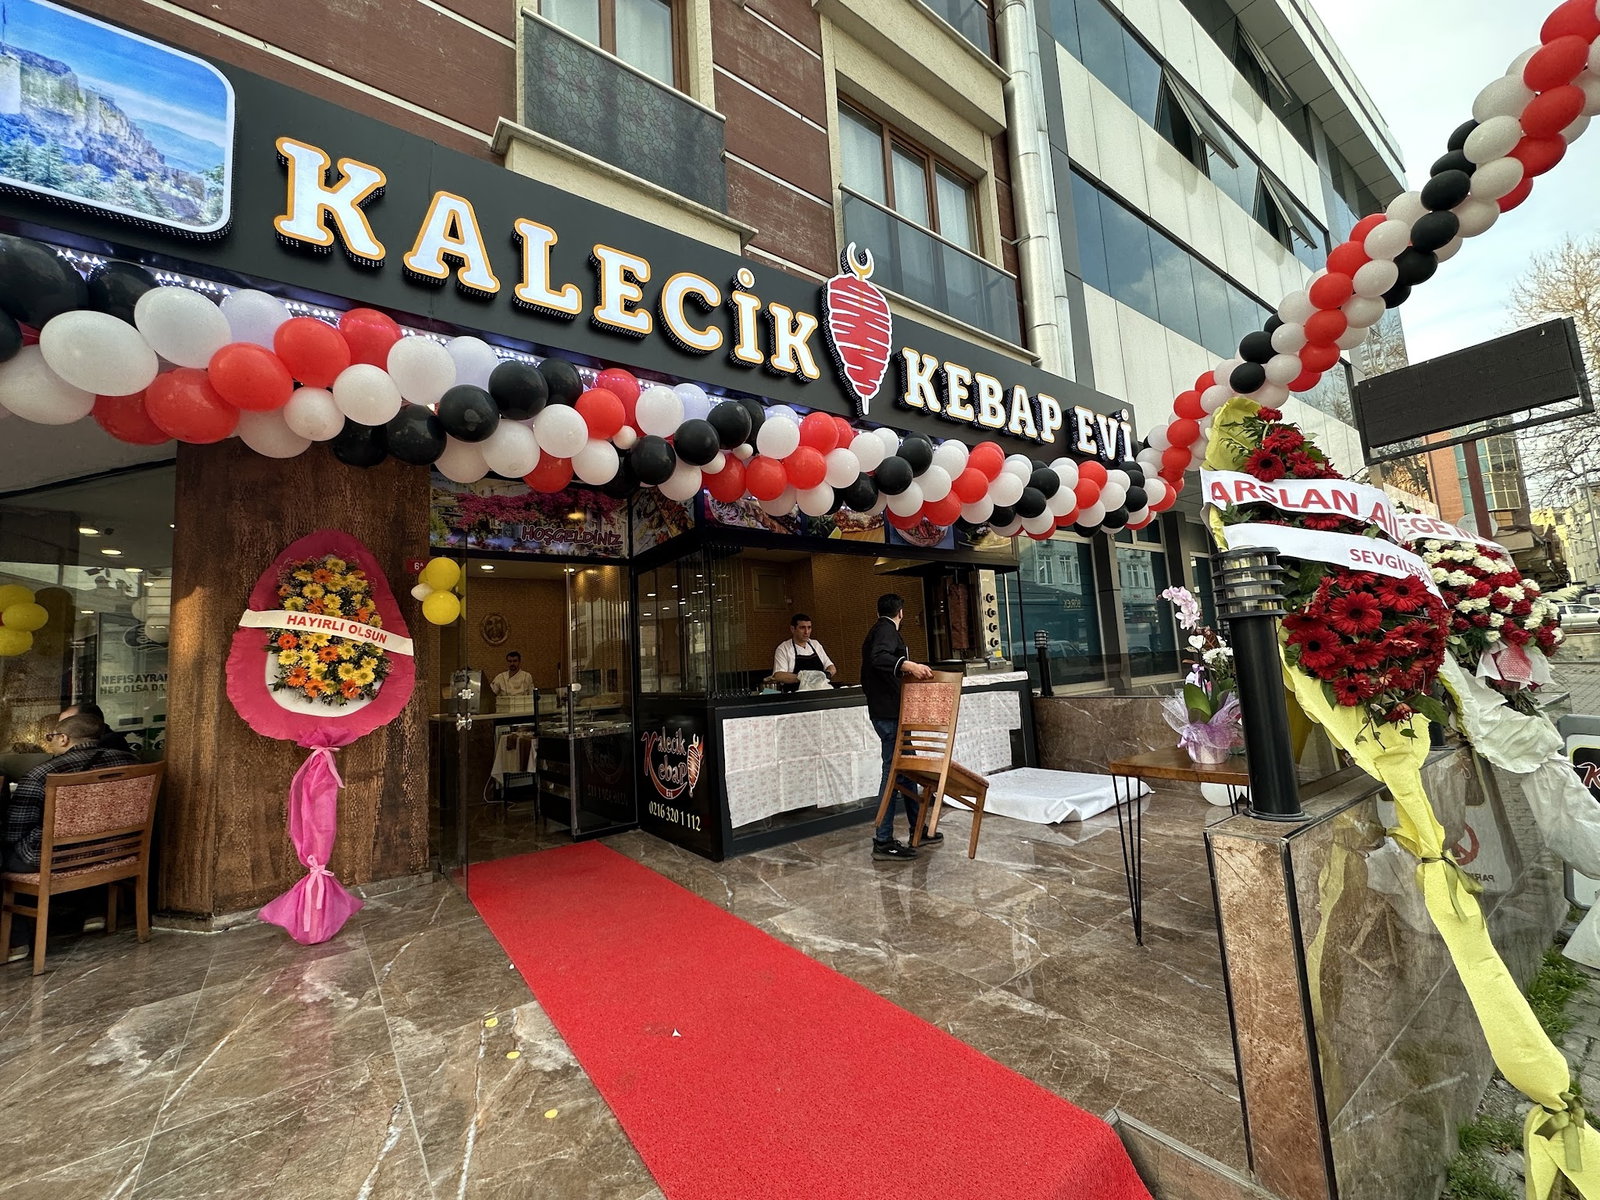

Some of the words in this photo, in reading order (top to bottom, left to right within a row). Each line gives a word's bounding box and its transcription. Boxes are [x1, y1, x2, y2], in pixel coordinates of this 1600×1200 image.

[274, 136, 821, 381] KALECİK
[899, 346, 1062, 443] KEBAP
[1071, 405, 1135, 462] EVİ
[1210, 480, 1359, 515] ARSLAN
[521, 525, 624, 546] HOŞGELDİNİZ
[286, 614, 345, 632] HAYIRLI
[348, 624, 388, 644] OLSUN
[648, 800, 666, 819] 0216
[665, 806, 679, 824] 320
